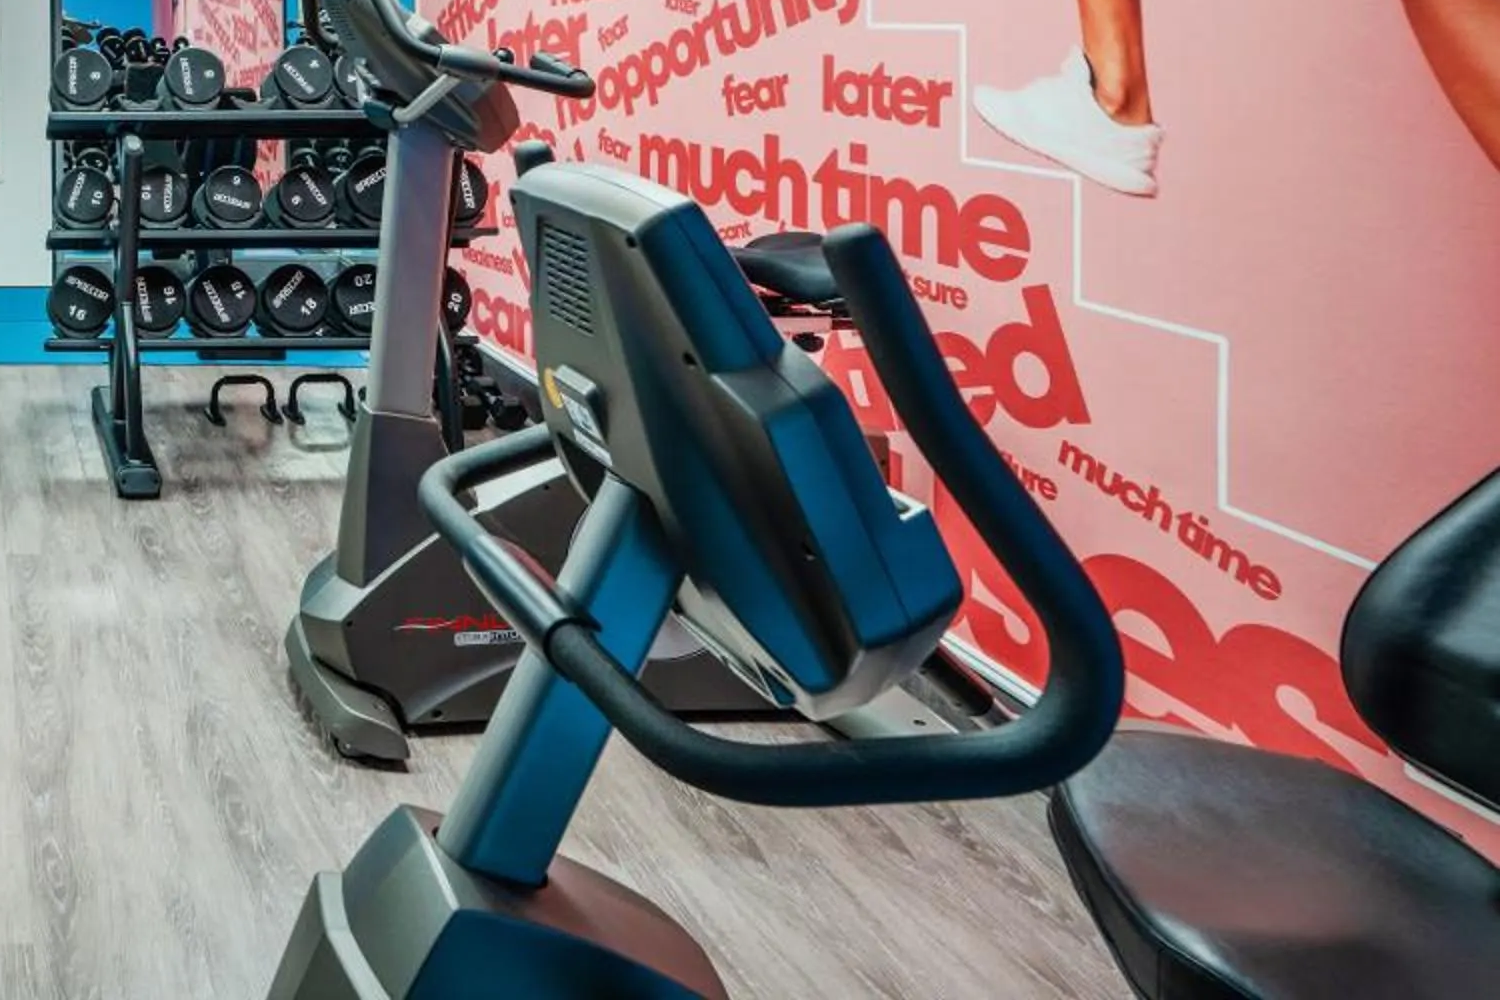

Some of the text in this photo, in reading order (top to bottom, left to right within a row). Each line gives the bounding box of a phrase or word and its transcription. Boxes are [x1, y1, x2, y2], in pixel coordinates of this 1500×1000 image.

[598, 14, 630, 51] fear
[721, 73, 790, 117] fear
[822, 53, 954, 128] later
[598, 126, 633, 163] fear
[639, 133, 810, 230] much
[812, 142, 1033, 283] time
[447, 292, 463, 313] 20
[912, 274, 969, 311] sure
[1057, 439, 1283, 602] much time
